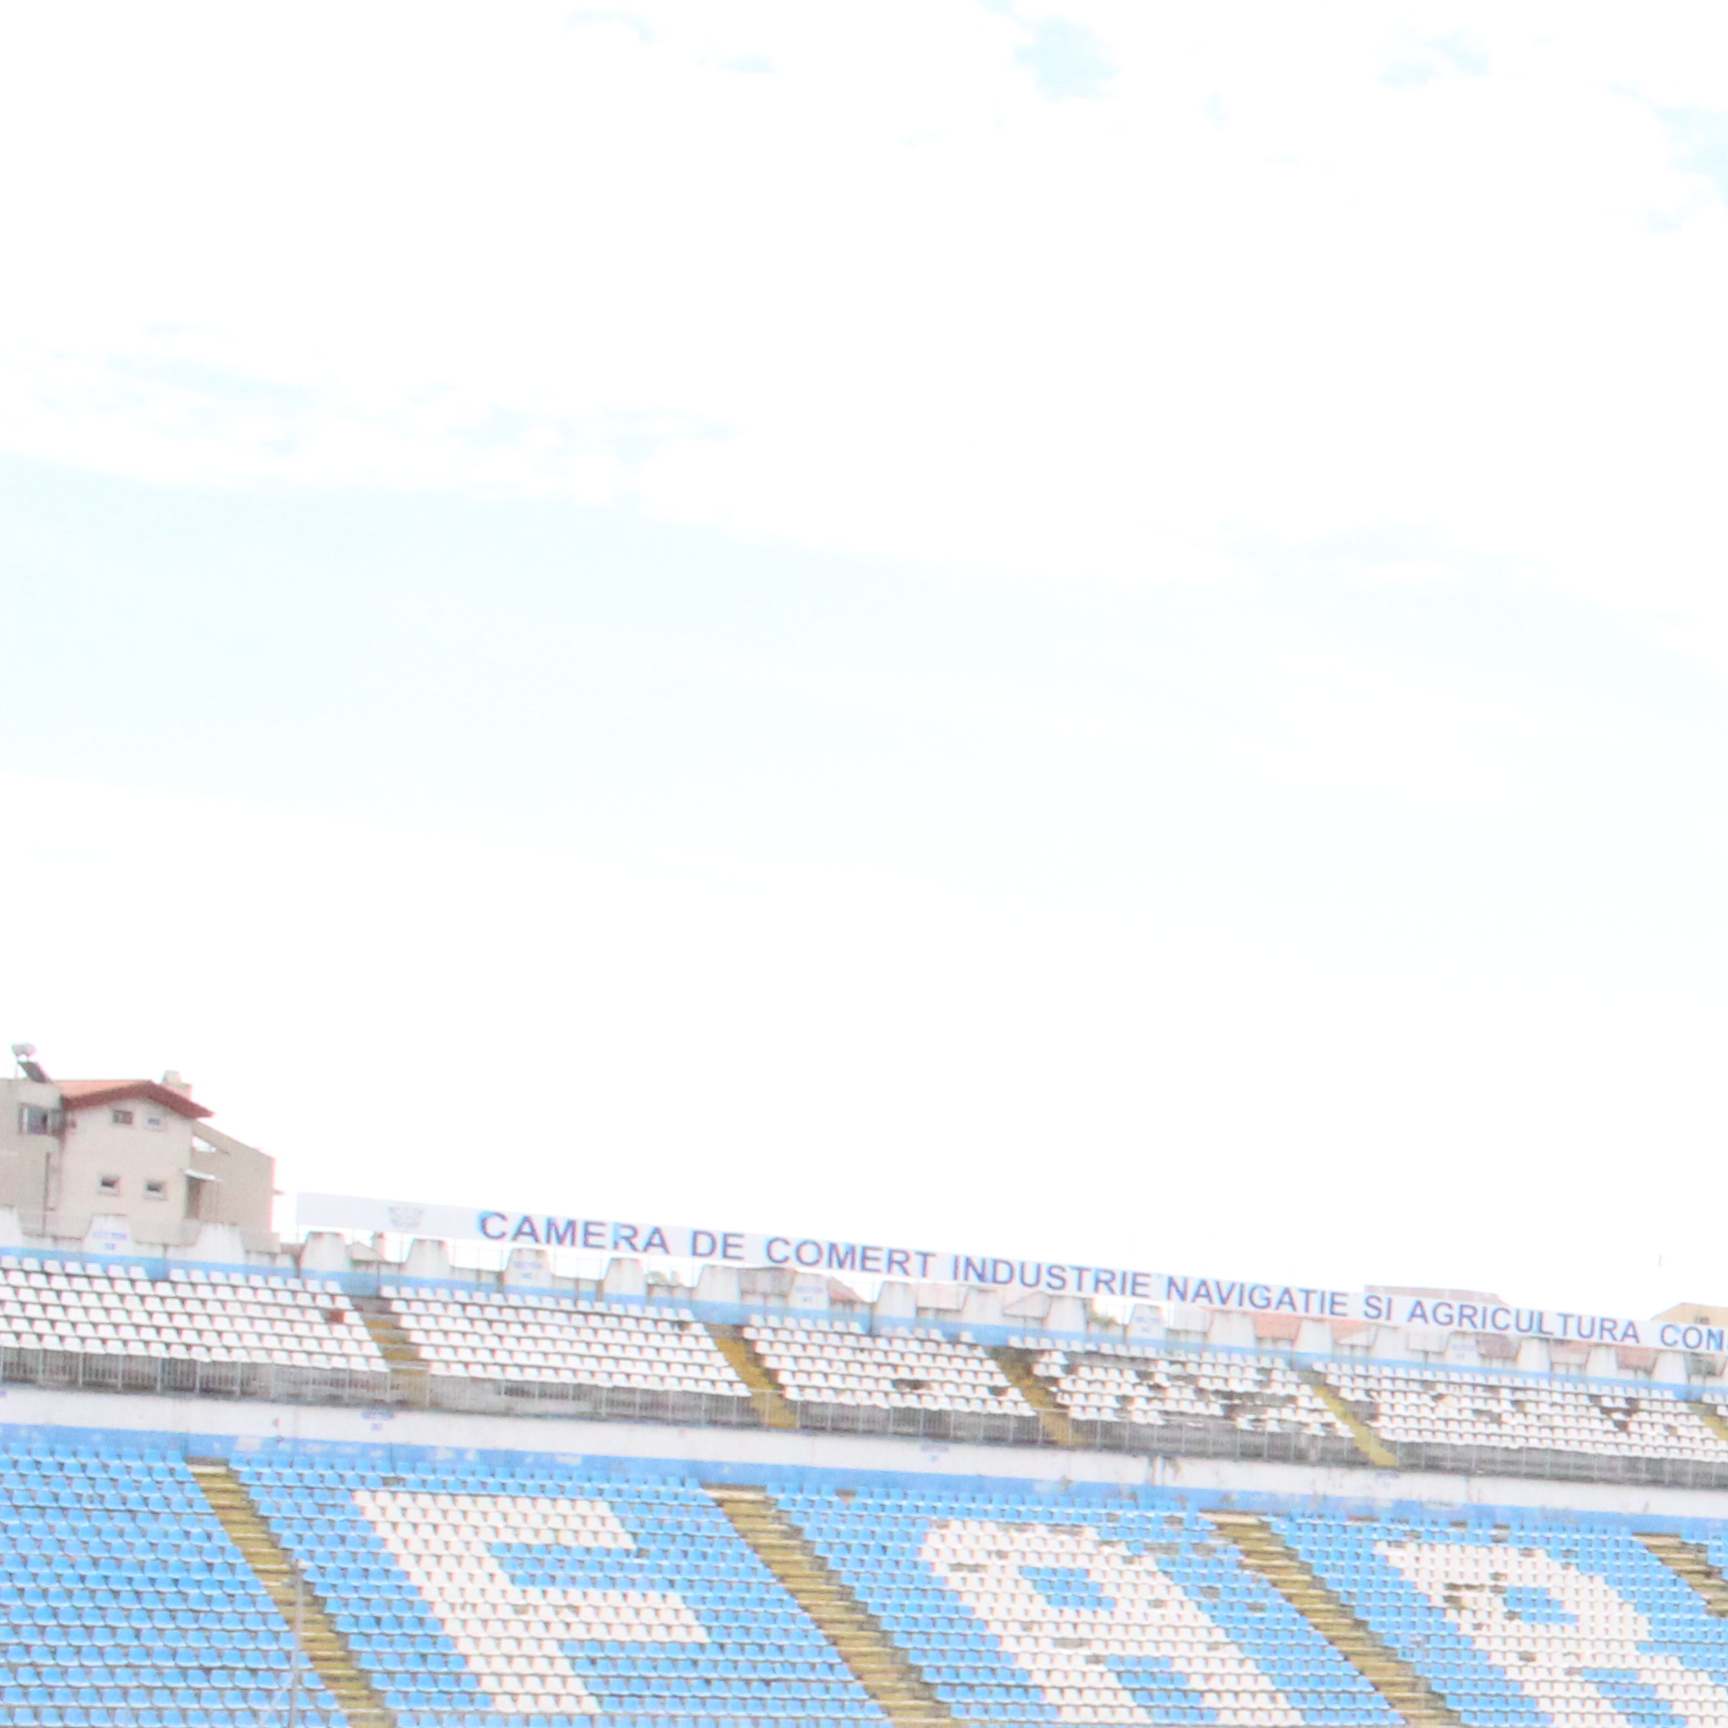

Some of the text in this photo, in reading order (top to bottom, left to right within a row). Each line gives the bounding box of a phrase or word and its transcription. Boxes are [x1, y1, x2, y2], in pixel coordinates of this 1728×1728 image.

[478, 1209, 671, 1257] CAMERA
[690, 1229, 746, 1261] DE
[764, 1236, 938, 1280] COMERT
[952, 1254, 1151, 1299] INDUSTRIE
[1164, 1274, 1352, 1318] NAVIGATIE
[1362, 1293, 1396, 1323] SI
[1405, 1300, 1642, 1346] AGRICULTURA
